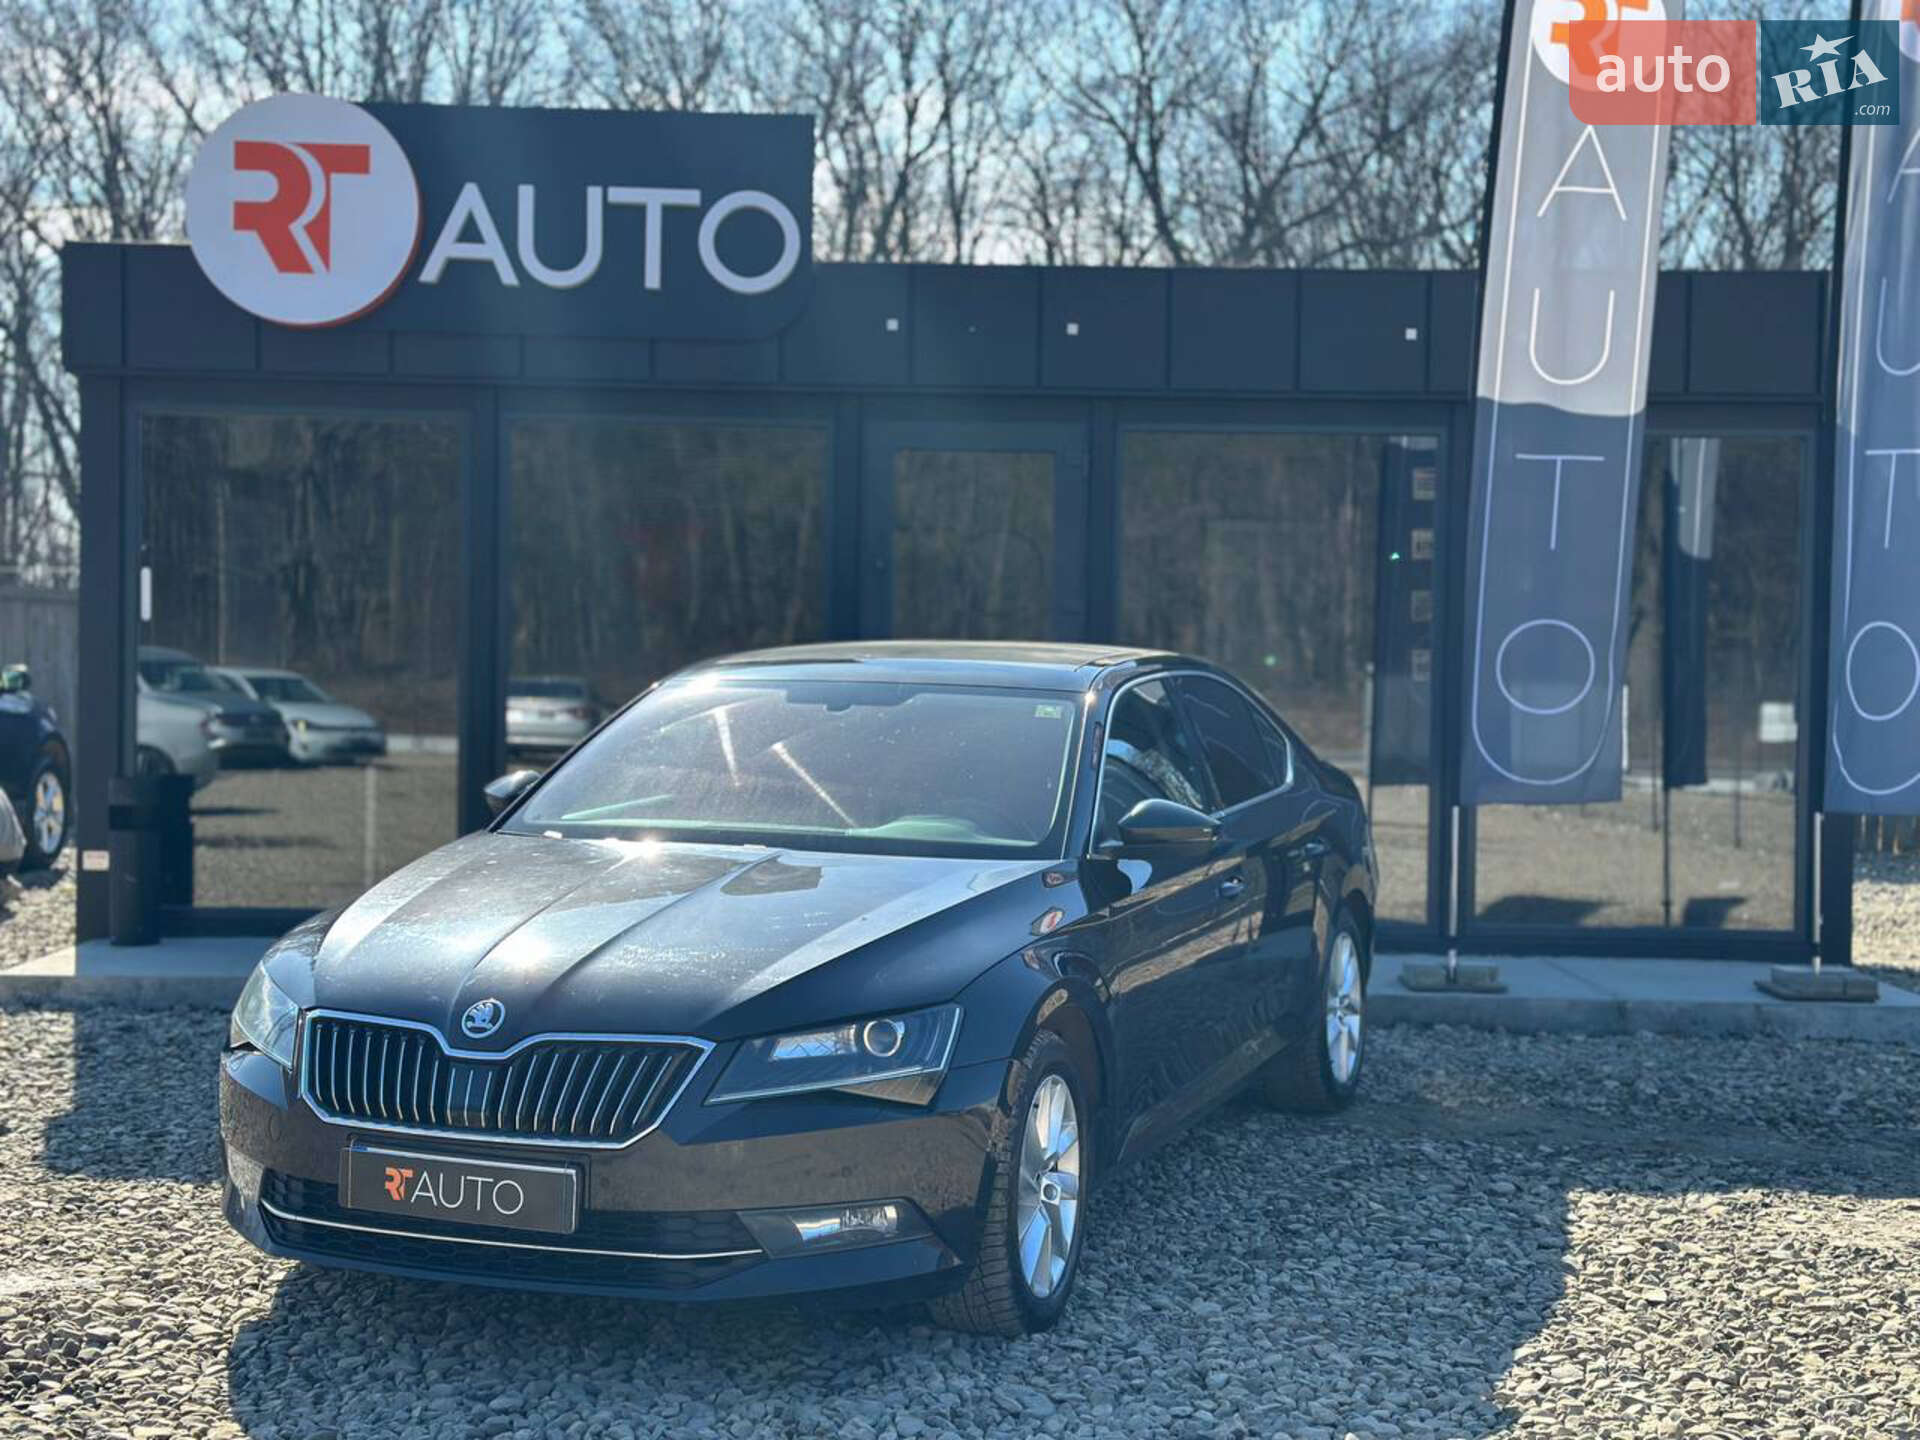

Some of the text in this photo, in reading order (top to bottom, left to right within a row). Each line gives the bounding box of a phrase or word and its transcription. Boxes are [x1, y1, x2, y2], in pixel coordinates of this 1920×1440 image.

[233, 140, 801, 295] RT AUTO
[1496, 124, 1627, 715] AUTO
[410, 1170, 525, 1215] AUTO
